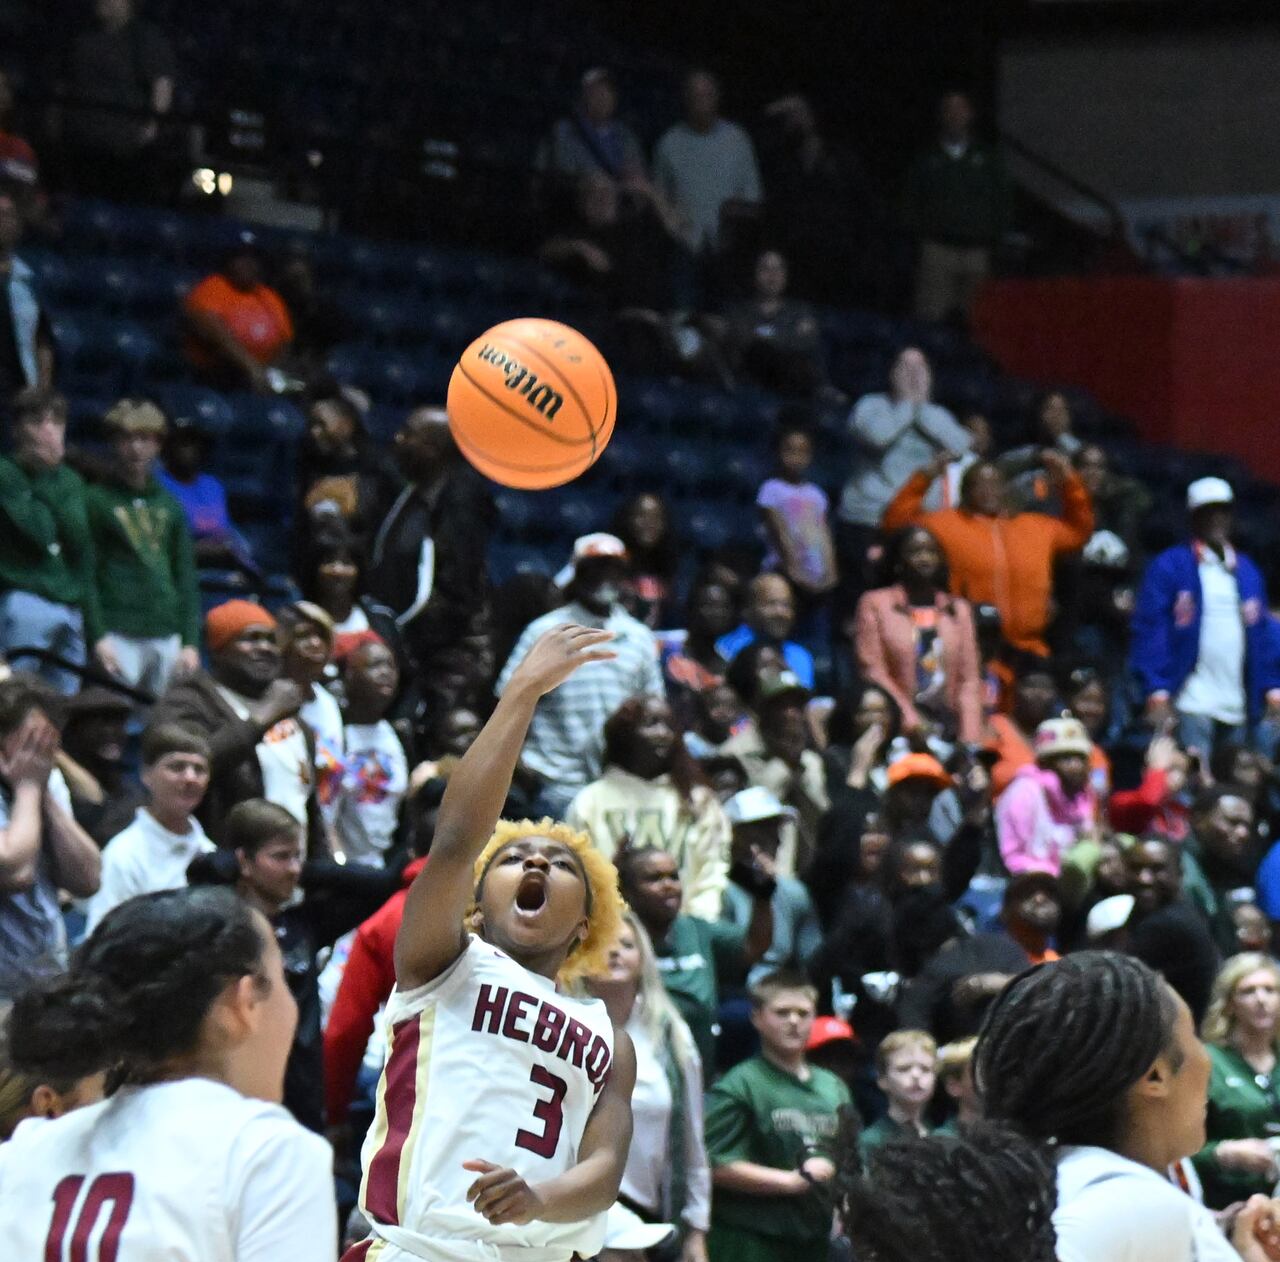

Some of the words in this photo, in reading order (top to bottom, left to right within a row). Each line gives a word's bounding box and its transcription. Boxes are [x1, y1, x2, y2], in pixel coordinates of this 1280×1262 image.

[478, 343, 564, 422] Wilson
[471, 983, 612, 1094] HEBRO
[514, 1063, 568, 1160] 3
